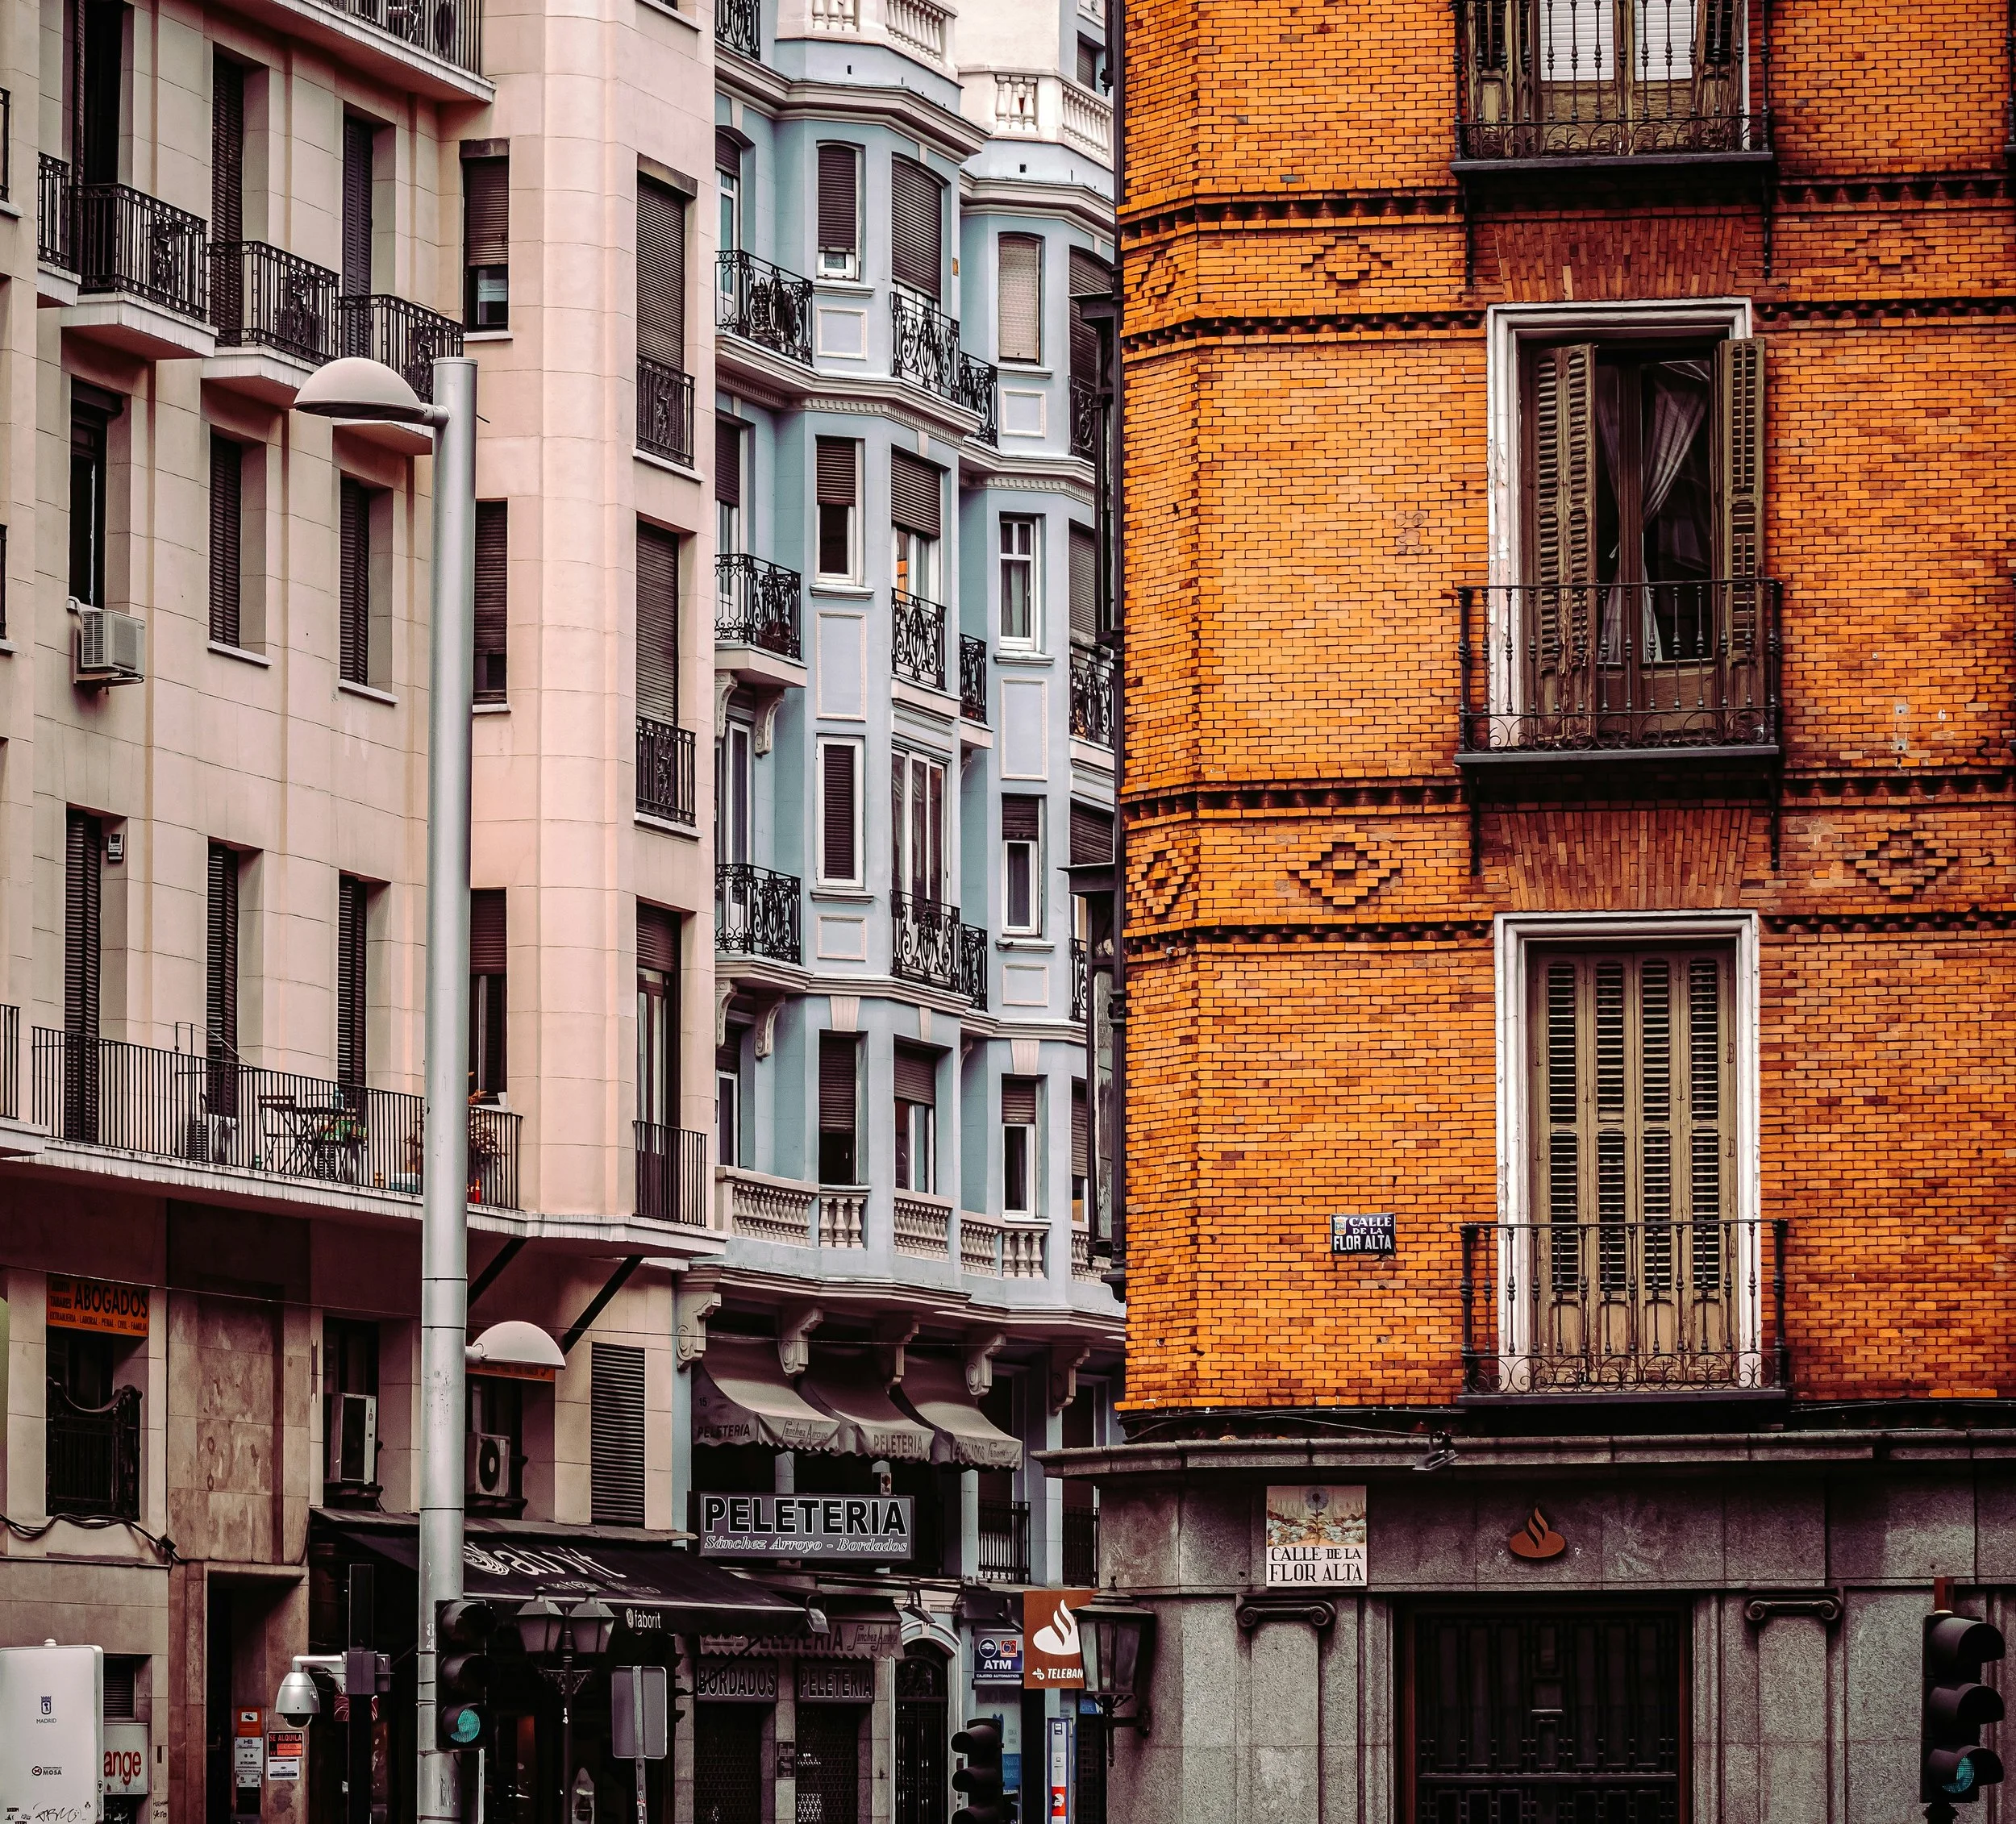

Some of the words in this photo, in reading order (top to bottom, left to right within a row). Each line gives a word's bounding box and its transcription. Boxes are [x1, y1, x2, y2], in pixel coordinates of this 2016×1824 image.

[1349, 1218, 1391, 1226] CALLE
[1334, 1235, 1361, 1251] FLOR
[1365, 1235, 1392, 1249] ALTA
[74, 1283, 148, 1318] ABOGADOS
[697, 1423, 751, 1439] PELETERIA
[873, 1434, 923, 1454] PELETERIA
[704, 1497, 907, 1536] PELETERIA
[705, 1535, 767, 1550] Sánchez
[769, 1537, 823, 1554] Arroyo
[837, 1538, 908, 1552] Bordados
[1271, 1547, 1322, 1561] CALLE
[1326, 1548, 1343, 1560] DE
[1344, 1548, 1363, 1560] LA
[465, 1541, 627, 1578] faboit
[1268, 1563, 1318, 1582] FLOR
[1322, 1563, 1364, 1581] ALTA
[635, 1610, 661, 1629] faborit
[984, 1660, 1012, 1670] ATM
[697, 1666, 776, 1697] BORDADOS
[799, 1668, 873, 1698] PELETERIA
[278, 1734, 302, 1742] ALQUILA
[103, 1751, 141, 1786] ange
